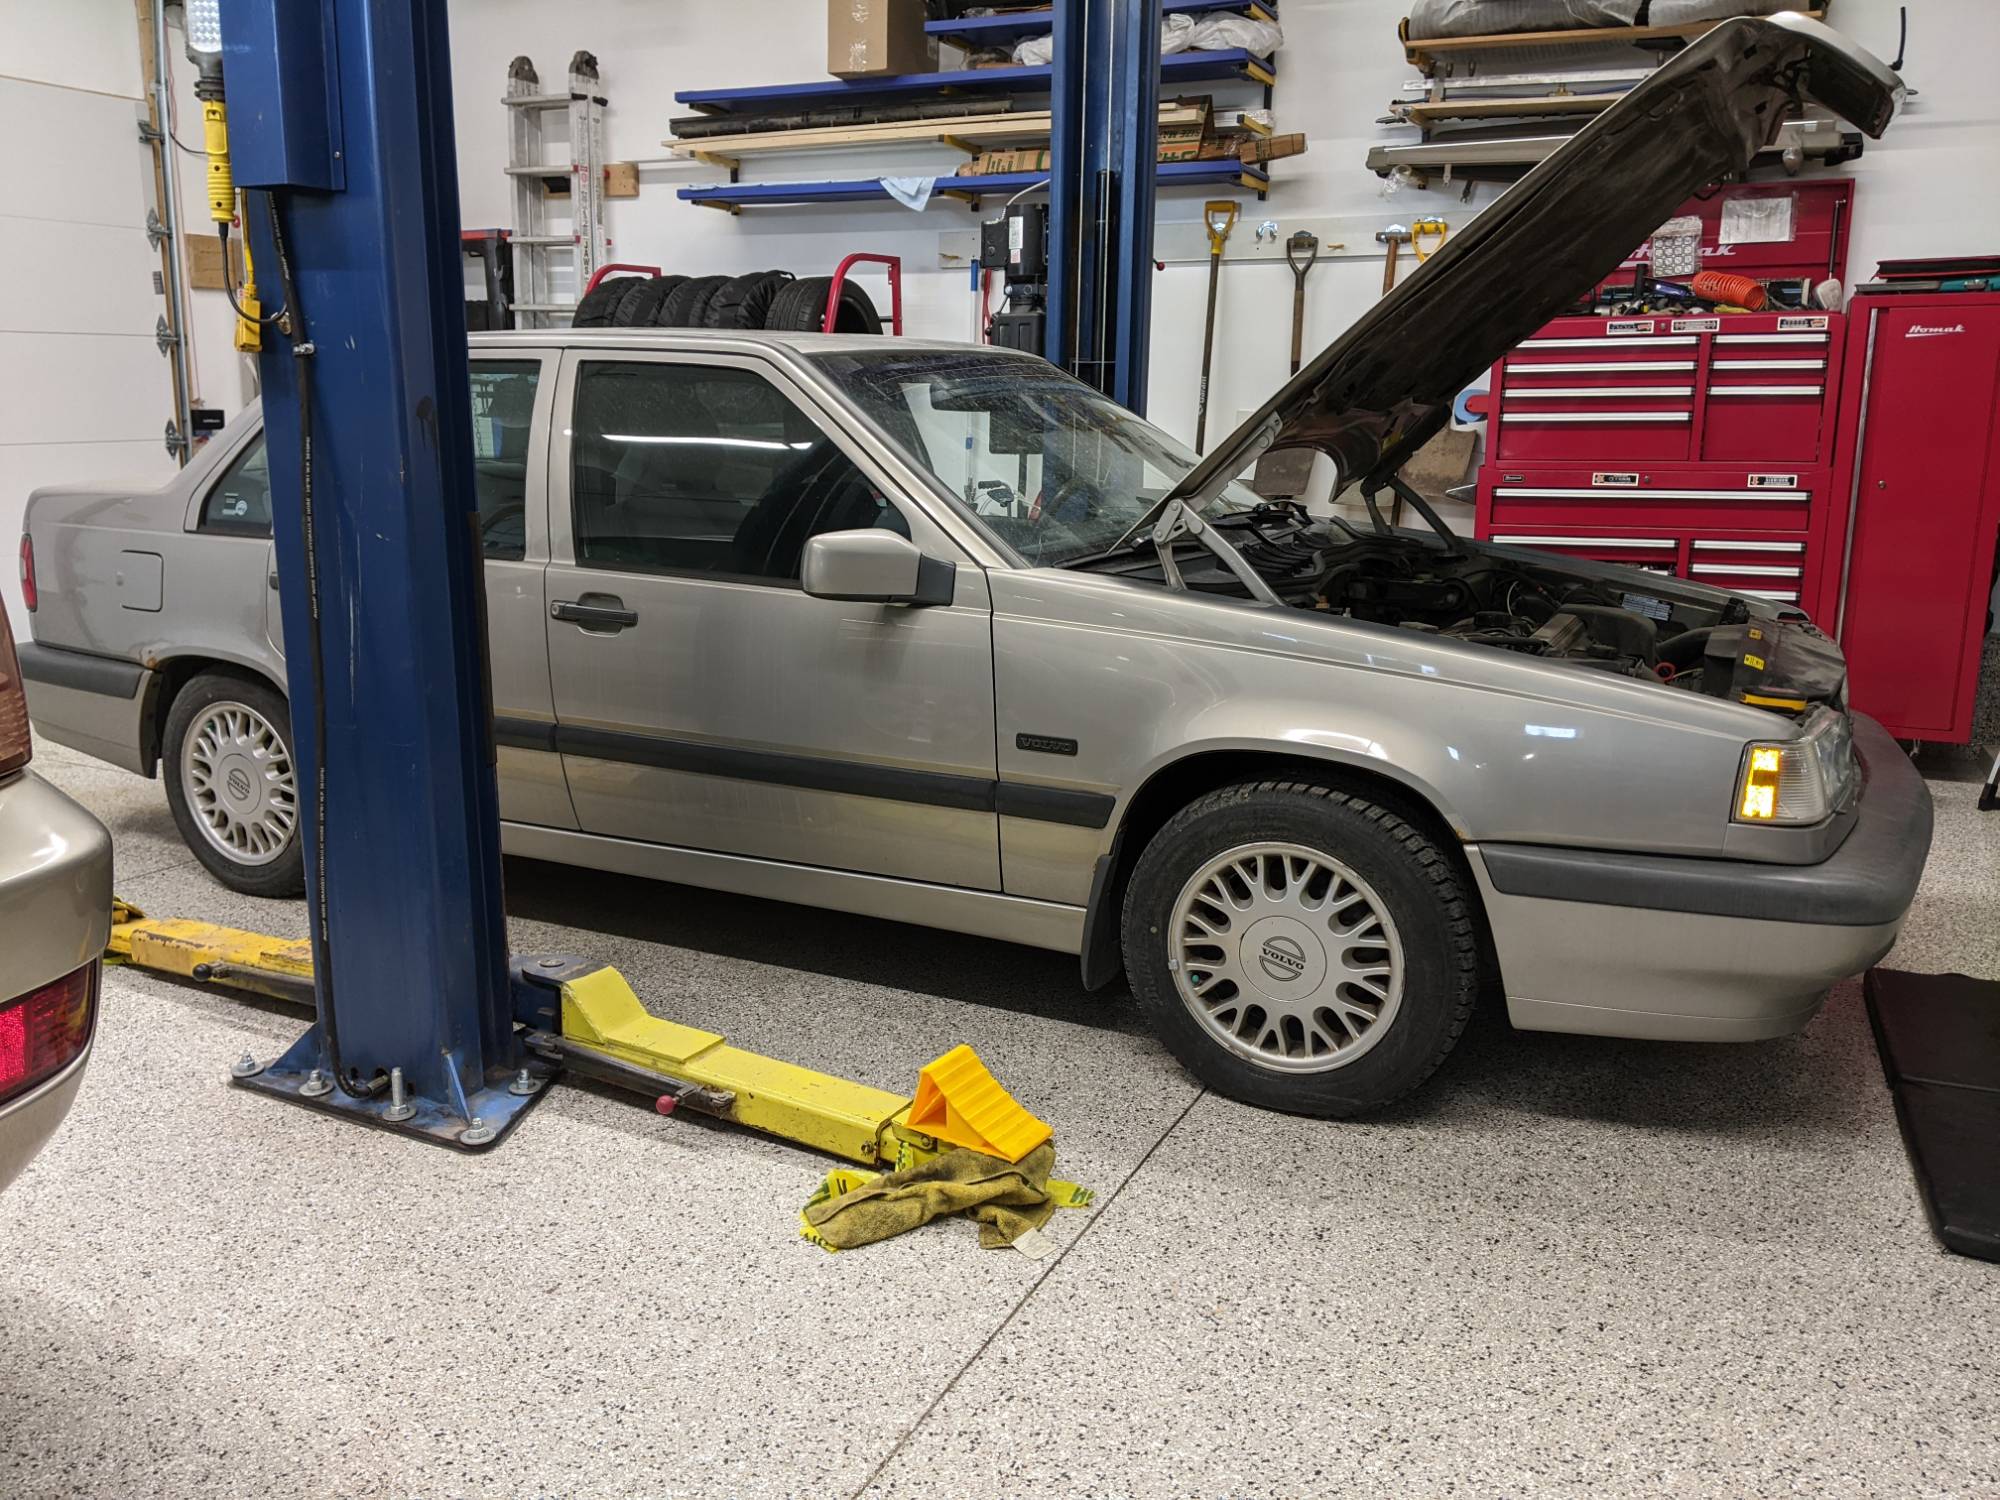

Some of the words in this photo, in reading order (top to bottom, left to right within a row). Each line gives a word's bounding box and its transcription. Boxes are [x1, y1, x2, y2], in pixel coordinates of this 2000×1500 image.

[1907, 324, 1966, 334] Homak
[1020, 736, 1074, 752] VOLVO
[1261, 946, 1305, 971] VOLVO
